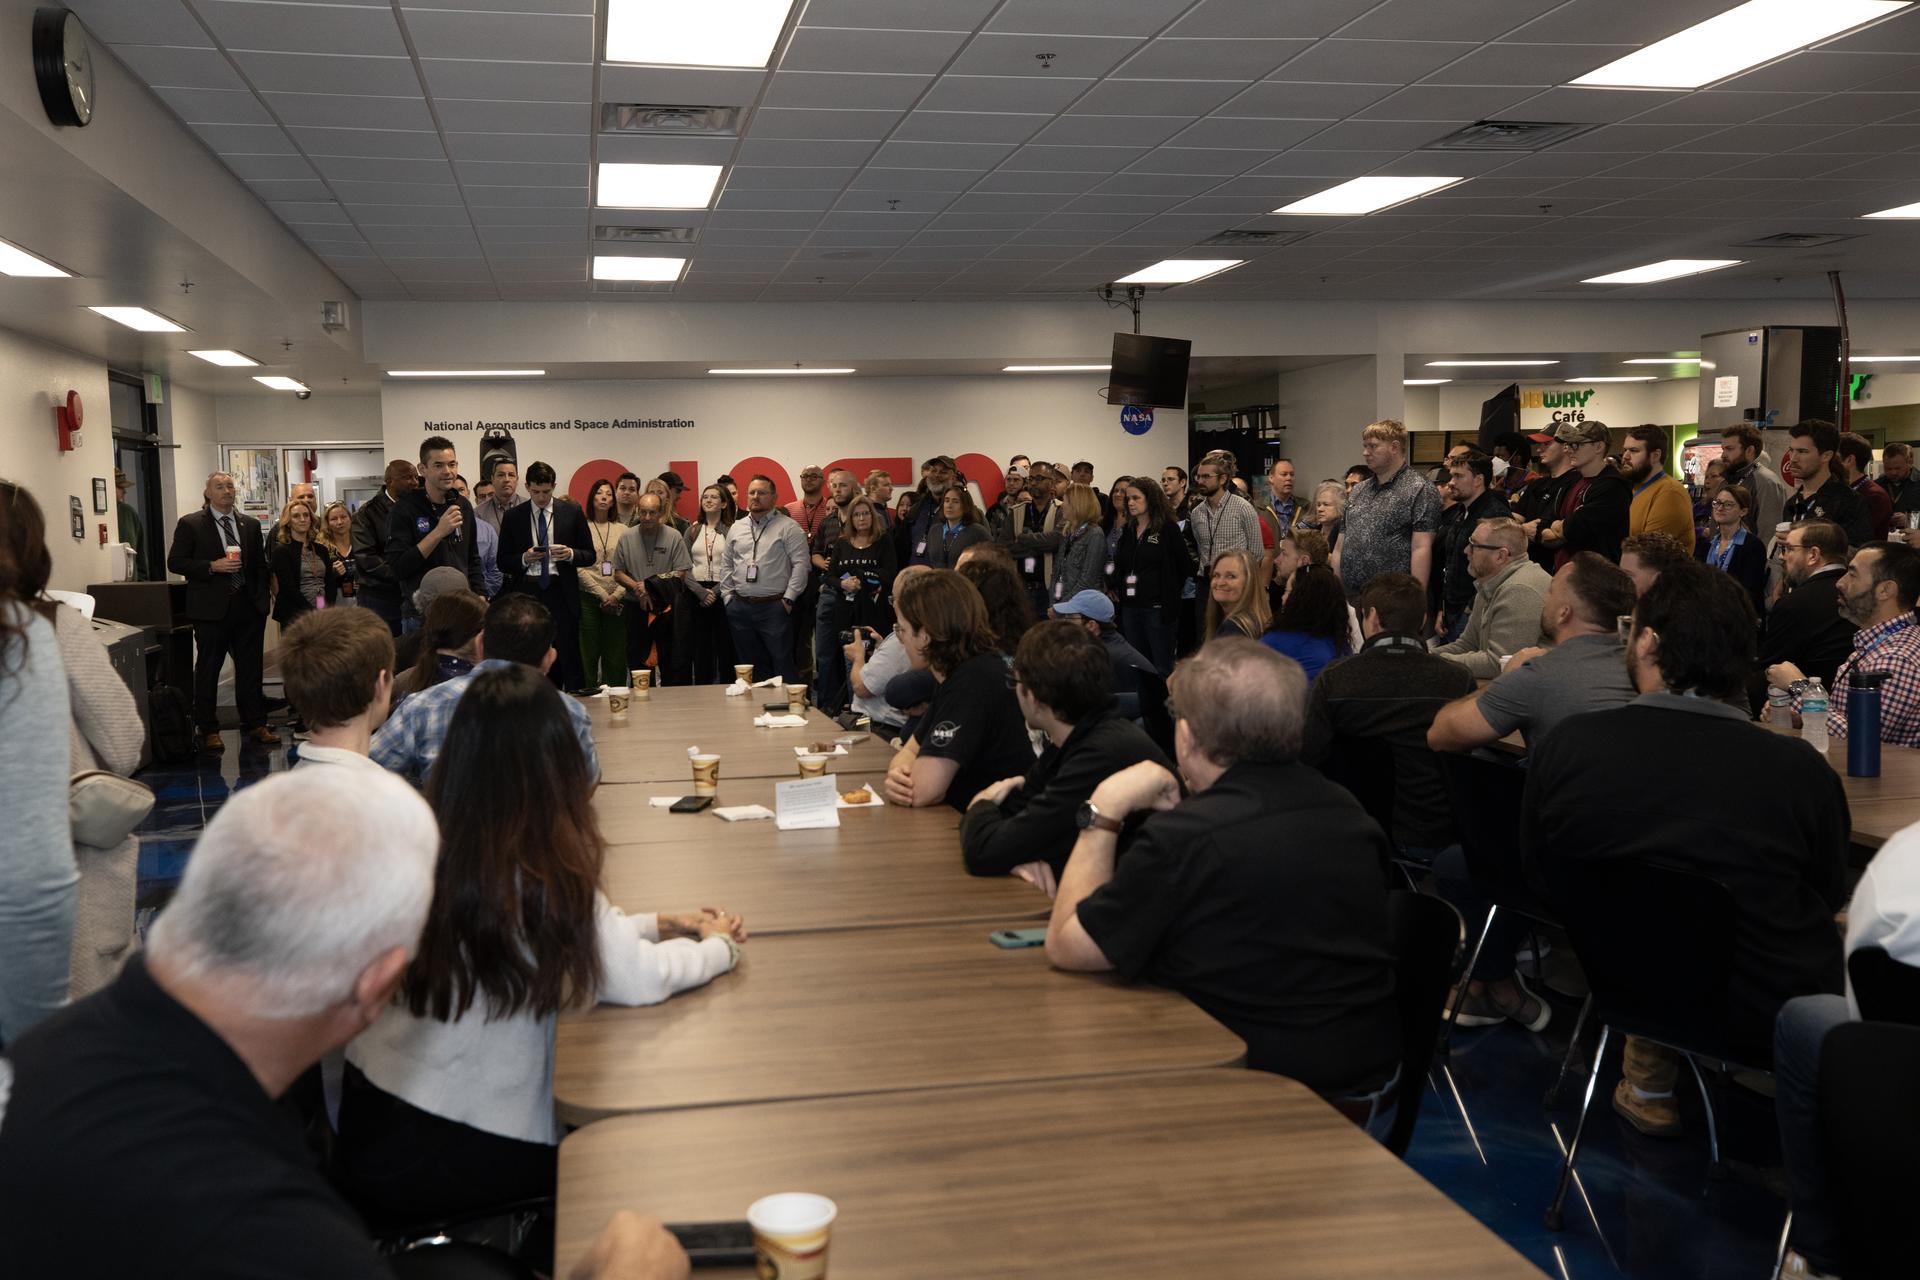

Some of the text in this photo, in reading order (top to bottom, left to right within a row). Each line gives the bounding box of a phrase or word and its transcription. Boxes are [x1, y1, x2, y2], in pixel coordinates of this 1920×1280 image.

[1520, 388, 1595, 408] UBWAY
[1123, 413, 1153, 422] NASA
[1552, 410, 1585, 423] Café
[424, 418, 695, 431] National Aeronautics and Space Administration
[838, 559, 878, 567] ARTEMIS
